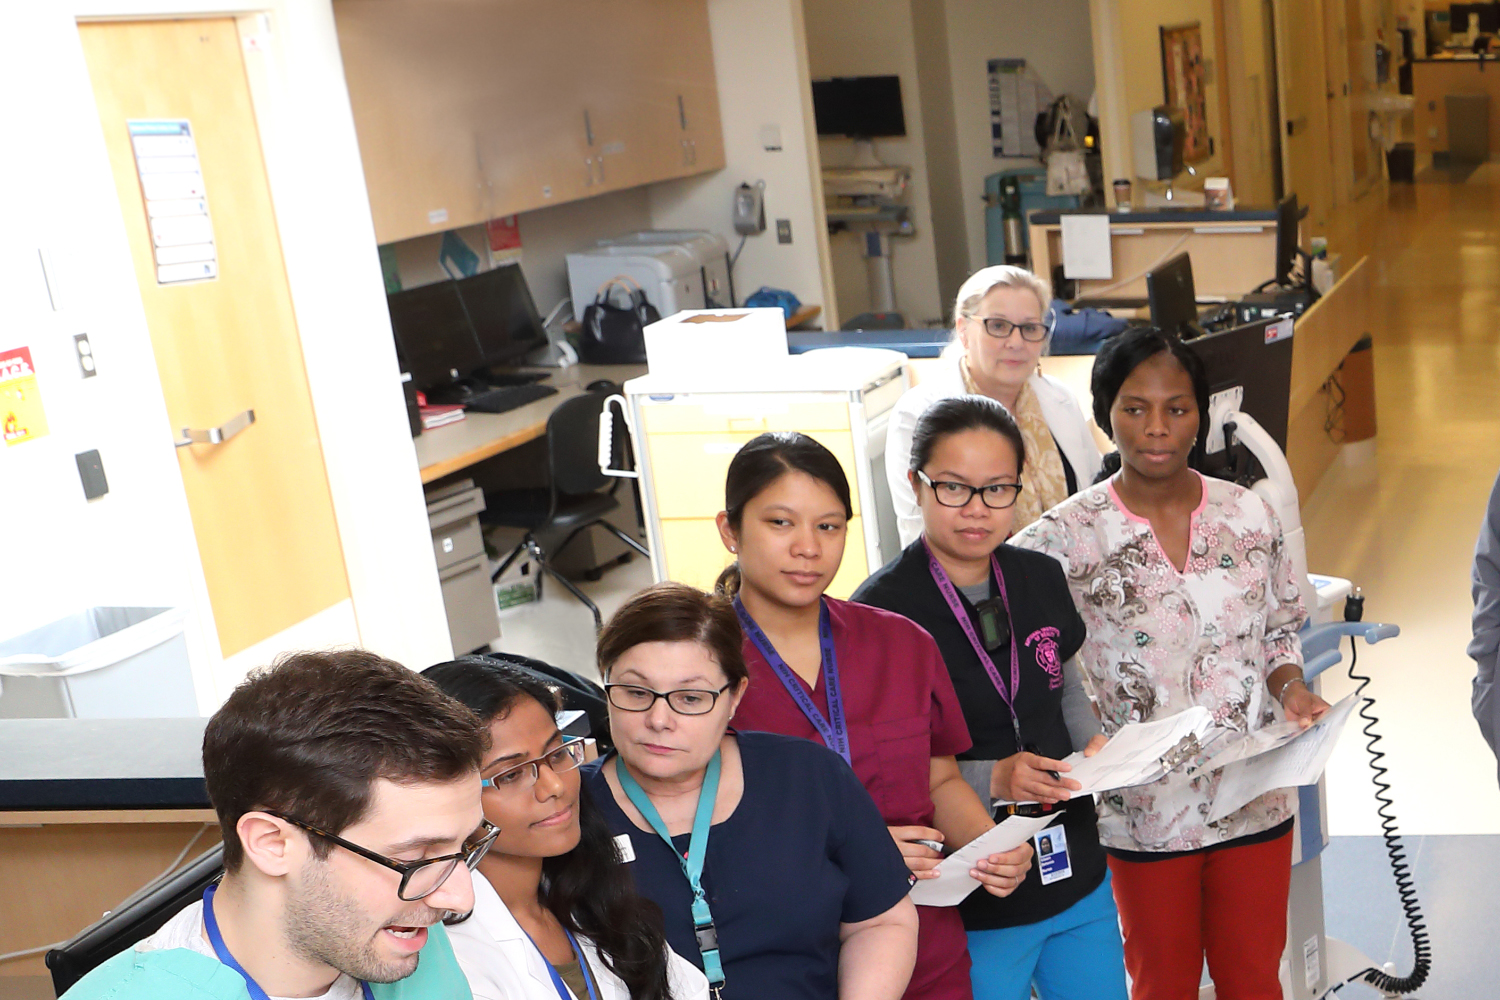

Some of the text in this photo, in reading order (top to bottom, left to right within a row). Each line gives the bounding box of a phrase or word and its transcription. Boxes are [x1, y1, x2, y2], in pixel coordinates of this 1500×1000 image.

[931, 562, 960, 609] CARE NURSE
[755, 631, 775, 657] NURSE
[969, 631, 990, 665] CRITICAL
[988, 666, 1001, 686] CARE
[824, 647, 835, 674] NURSE
[778, 663, 828, 733] NIH CRITICAL CARE
[829, 673, 838, 698] CARE
[831, 698, 844, 735] CRITICAL
[837, 736, 846, 754] NIH
